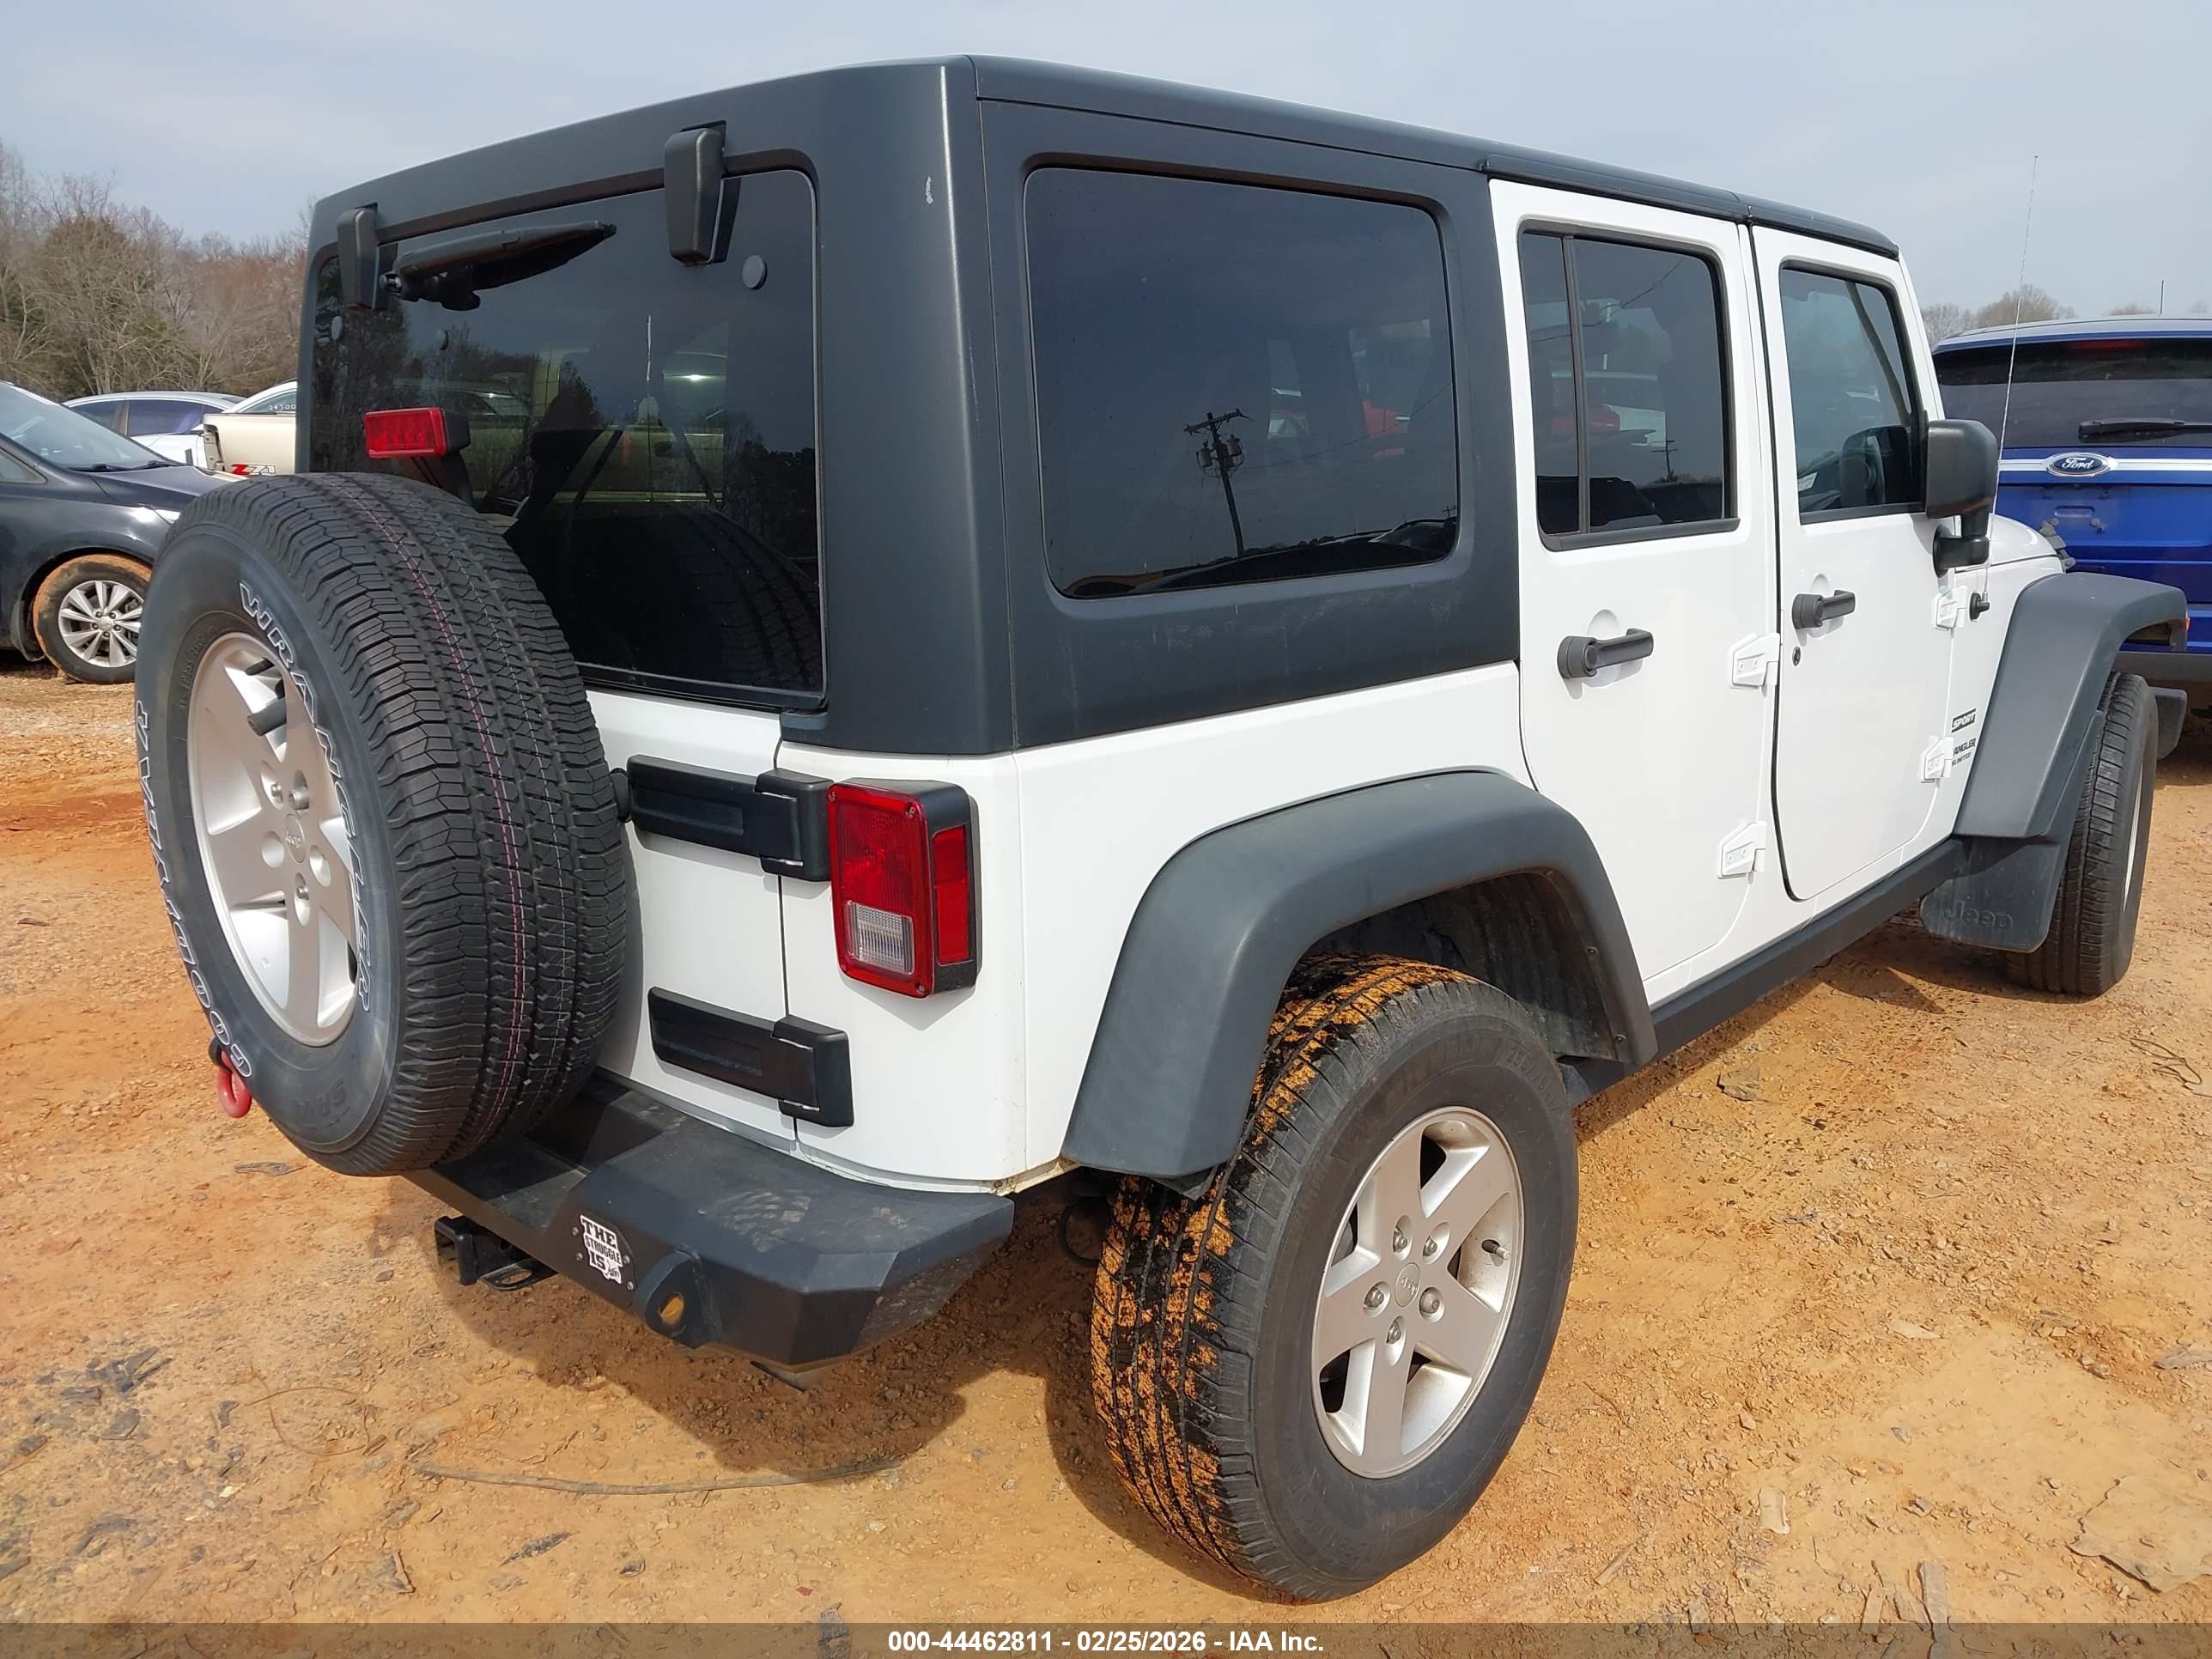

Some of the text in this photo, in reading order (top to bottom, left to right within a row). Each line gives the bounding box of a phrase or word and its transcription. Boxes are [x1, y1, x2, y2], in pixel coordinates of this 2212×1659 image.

[231, 464, 276, 477] Z71
[2061, 457, 2095, 470] Ford
[1952, 711, 1976, 730] SPORT
[1954, 738, 1977, 757] ANGLER
[240, 582, 371, 1012] WRANGLER
[136, 700, 252, 1078] GOODYEAR
[1943, 899, 2013, 931] Jeep
[581, 1218, 617, 1249] THE
[585, 1236, 622, 1266] STRUGGLE
[590, 1250, 606, 1270] IS
